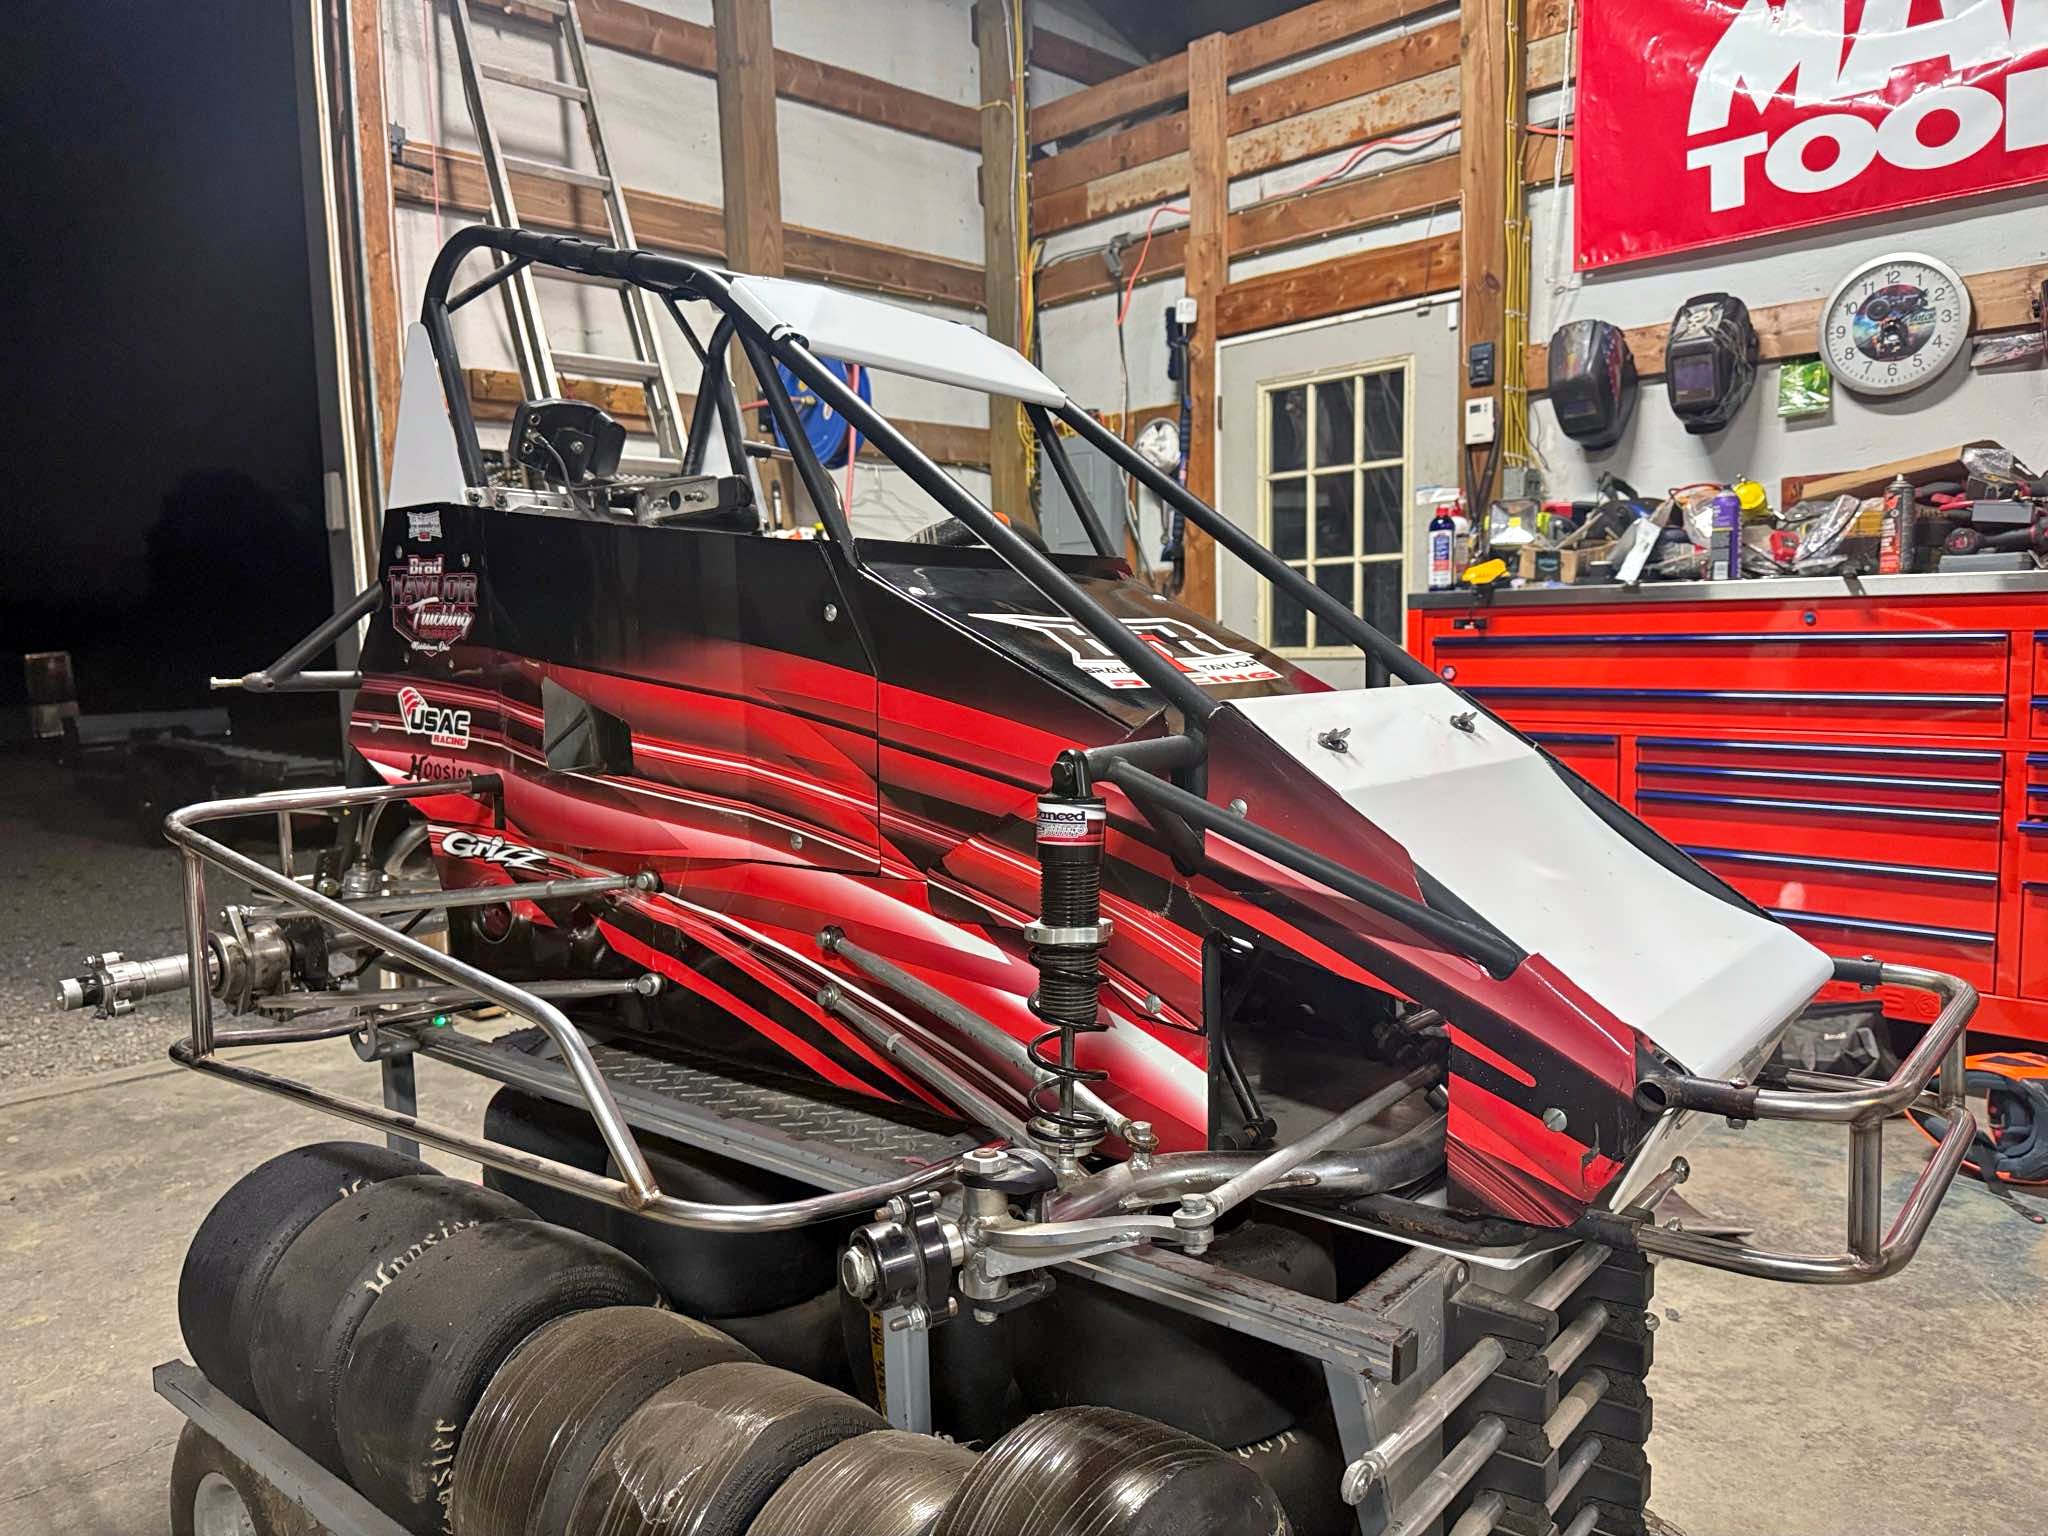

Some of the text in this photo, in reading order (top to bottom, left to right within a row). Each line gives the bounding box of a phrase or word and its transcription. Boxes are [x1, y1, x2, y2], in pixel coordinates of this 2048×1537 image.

[1688, 0, 2048, 136] MA
[1885, 270, 1901, 284] 12
[1916, 274, 1922, 286] 1
[1862, 281, 1875, 295] 11
[1935, 287, 1945, 301] 2
[1844, 301, 1858, 315] 10
[1941, 309, 1952, 322] 3
[1836, 325, 1846, 339] 9
[1932, 334, 1942, 348] 4
[1844, 347, 1854, 360] 8
[1913, 353, 1922, 367] 5
[1863, 361, 1872, 375] 7
[1887, 363, 1897, 376] 6
[409, 556, 442, 574] Brad
[389, 573, 479, 606] TAYLOR
[408, 596, 473, 638] Trucking
[1198, 660, 1260, 671] TAYLOR
[410, 709, 469, 737] USAC
[433, 734, 466, 747] RACING
[402, 754, 473, 781] Hoosier
[1037, 811, 1086, 821] anced
